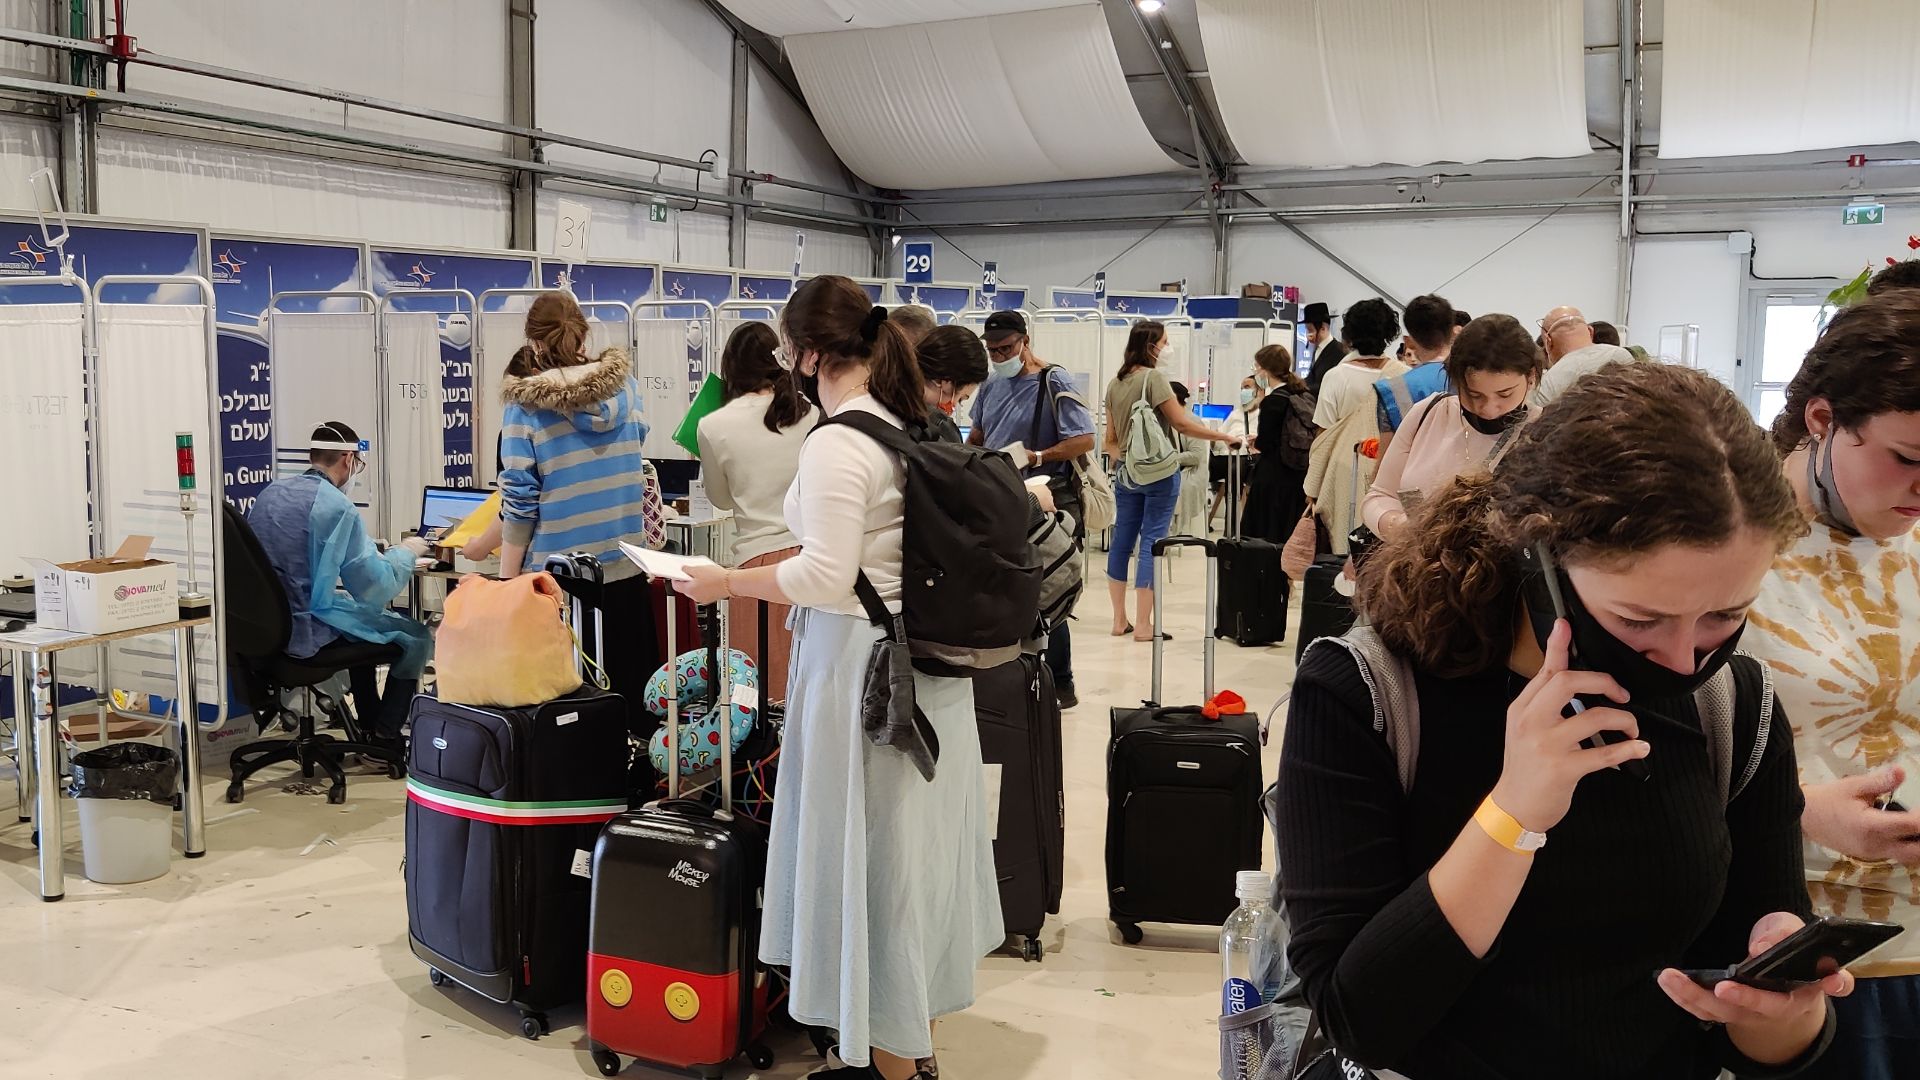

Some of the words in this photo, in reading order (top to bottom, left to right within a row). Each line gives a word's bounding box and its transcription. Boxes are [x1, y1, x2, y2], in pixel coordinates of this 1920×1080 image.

[561, 216, 585, 250] 31
[907, 255, 931, 273] 29
[983, 271, 996, 285] 28
[1095, 280, 1105, 293] 27
[1273, 291, 1284, 302] 25
